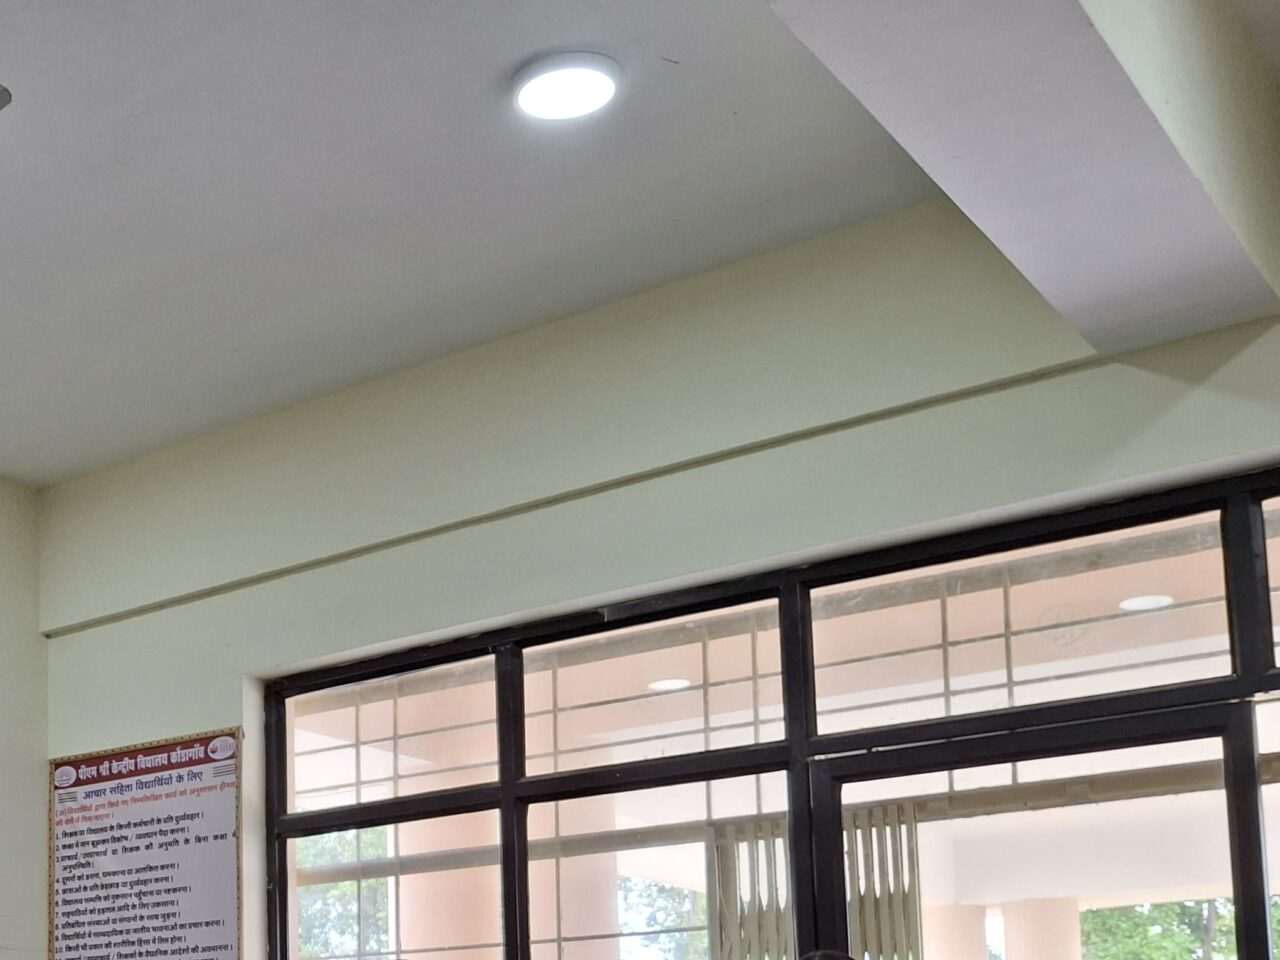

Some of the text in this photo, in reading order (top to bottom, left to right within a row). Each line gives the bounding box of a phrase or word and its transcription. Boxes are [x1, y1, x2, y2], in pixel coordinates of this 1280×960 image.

[82, 787, 106, 800] आचार
[176, 775, 184, 784] के
[187, 770, 203, 784] लिए
